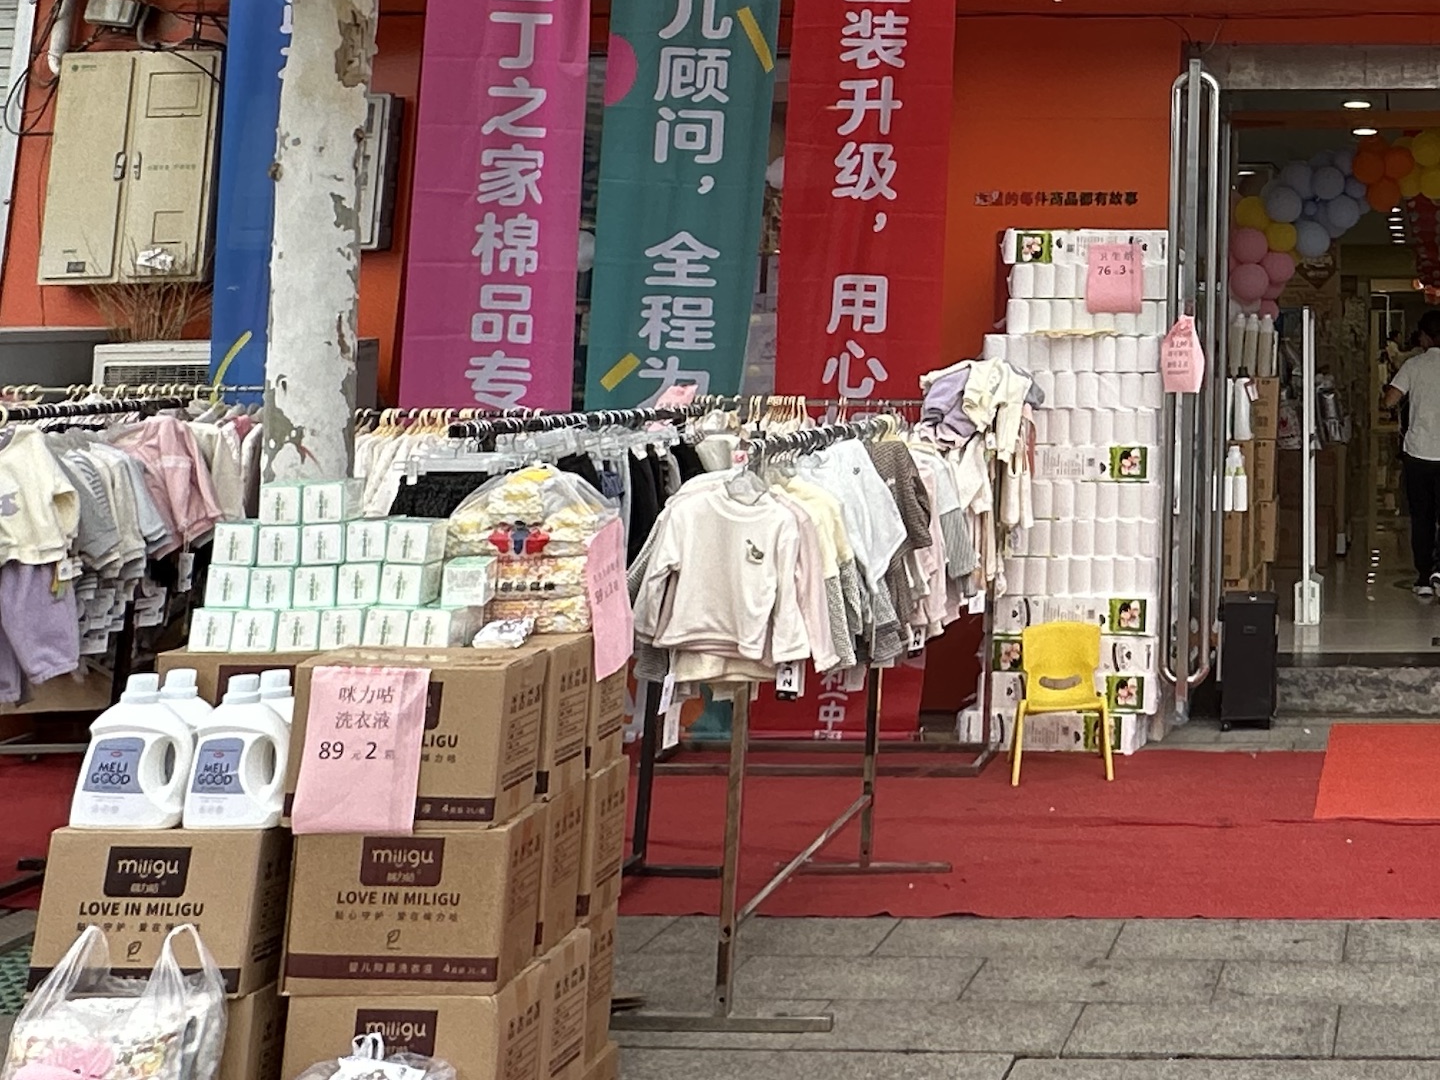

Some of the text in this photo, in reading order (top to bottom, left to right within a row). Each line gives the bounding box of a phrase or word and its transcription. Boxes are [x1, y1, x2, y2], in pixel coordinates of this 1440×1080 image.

[334, 711, 391, 730] 洗衣液
[91, 772, 131, 786] GOOD
[197, 773, 233, 786] GOOD
[372, 848, 434, 868] miligu
[117, 858, 179, 879] miligu
[336, 891, 461, 907] LOVE IN MILIGU
[79, 901, 204, 917] LOVE IN MILIGU
[365, 1020, 427, 1042] miligu
